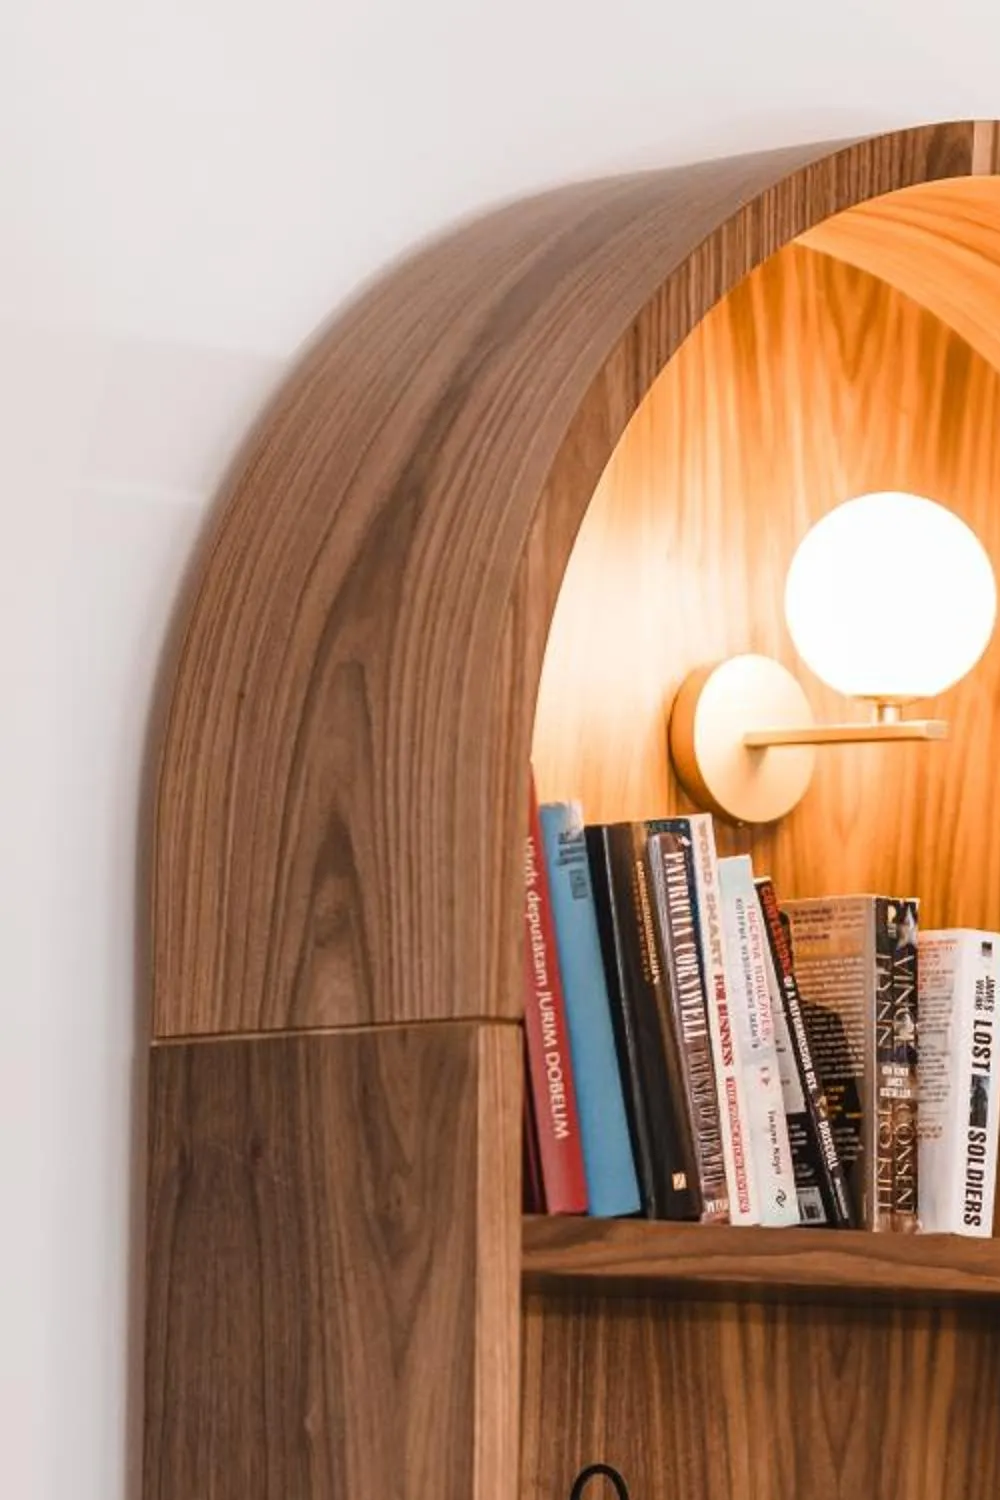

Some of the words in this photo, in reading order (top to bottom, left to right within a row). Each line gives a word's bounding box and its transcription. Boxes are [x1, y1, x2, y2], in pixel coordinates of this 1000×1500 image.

[664, 851, 694, 937] PATRICIA
[535, 990, 558, 1047] JURIM
[674, 943, 708, 1044] CORNWELL
[714, 974, 727, 1001] FOR
[717, 1003, 735, 1067] BUSINESS
[971, 1019, 993, 1073] LOST
[546, 1051, 570, 1140] DOBELIM
[818, 1121, 839, 1170] DRISCOLL
[964, 1130, 987, 1227] SOLDIERS
